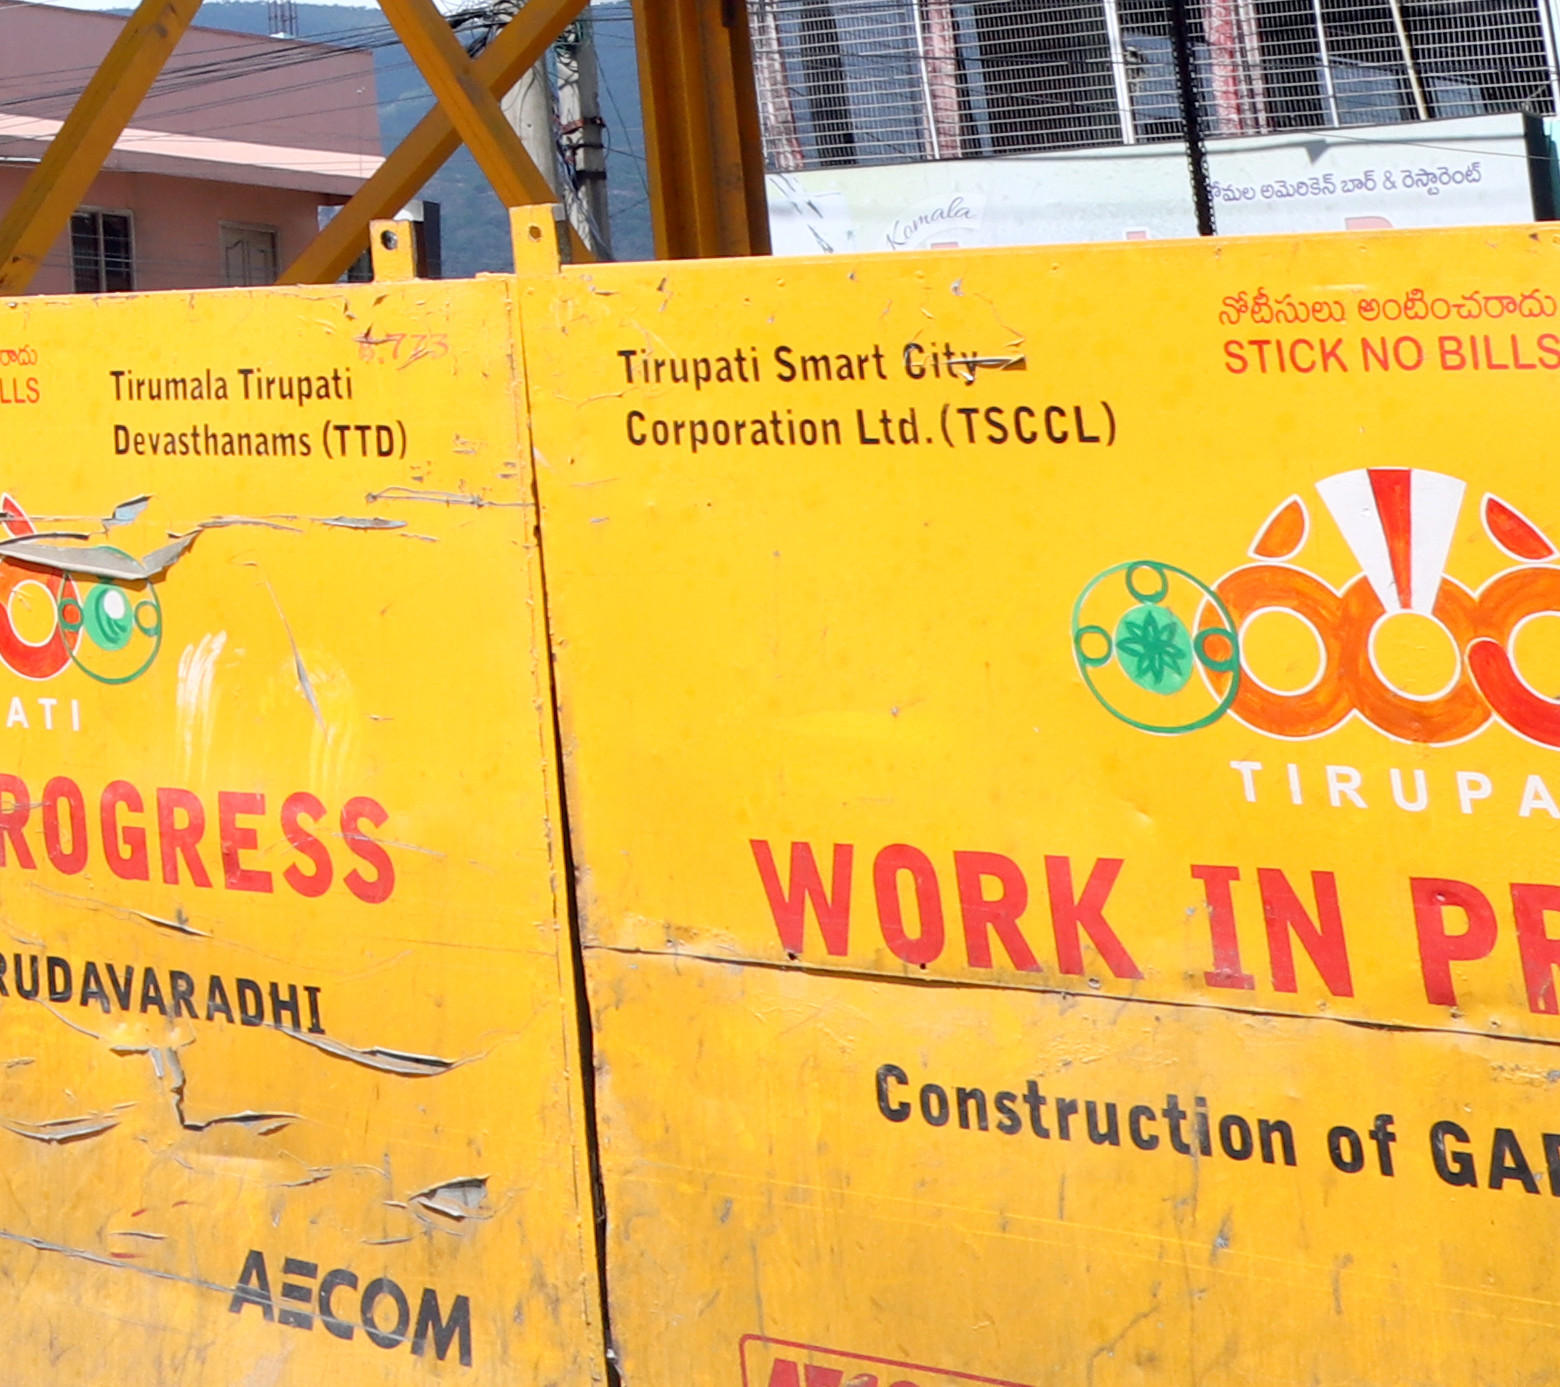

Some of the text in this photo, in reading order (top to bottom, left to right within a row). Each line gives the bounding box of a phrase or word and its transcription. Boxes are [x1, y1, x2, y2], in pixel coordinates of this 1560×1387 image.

[1341, 171, 1377, 194] బార్
[1383, 170, 1398, 191] &
[1219, 287, 1558, 325] నోటీసులు అంటించరాదు
[617, 342, 977, 390] Tirupati Smart City
[1224, 333, 1560, 374] STICK NO BILLS
[109, 366, 354, 410] Tirumala Tirupati
[114, 418, 408, 462] Devasthanams (TTD)
[626, 409, 842, 453] Corporation
[750, 838, 1145, 980] WORK
[1190, 863, 1354, 998] IN
[875, 1063, 1298, 1167] Construction
[1327, 1114, 1396, 1178] of
[230, 1250, 472, 1366] AECOM
